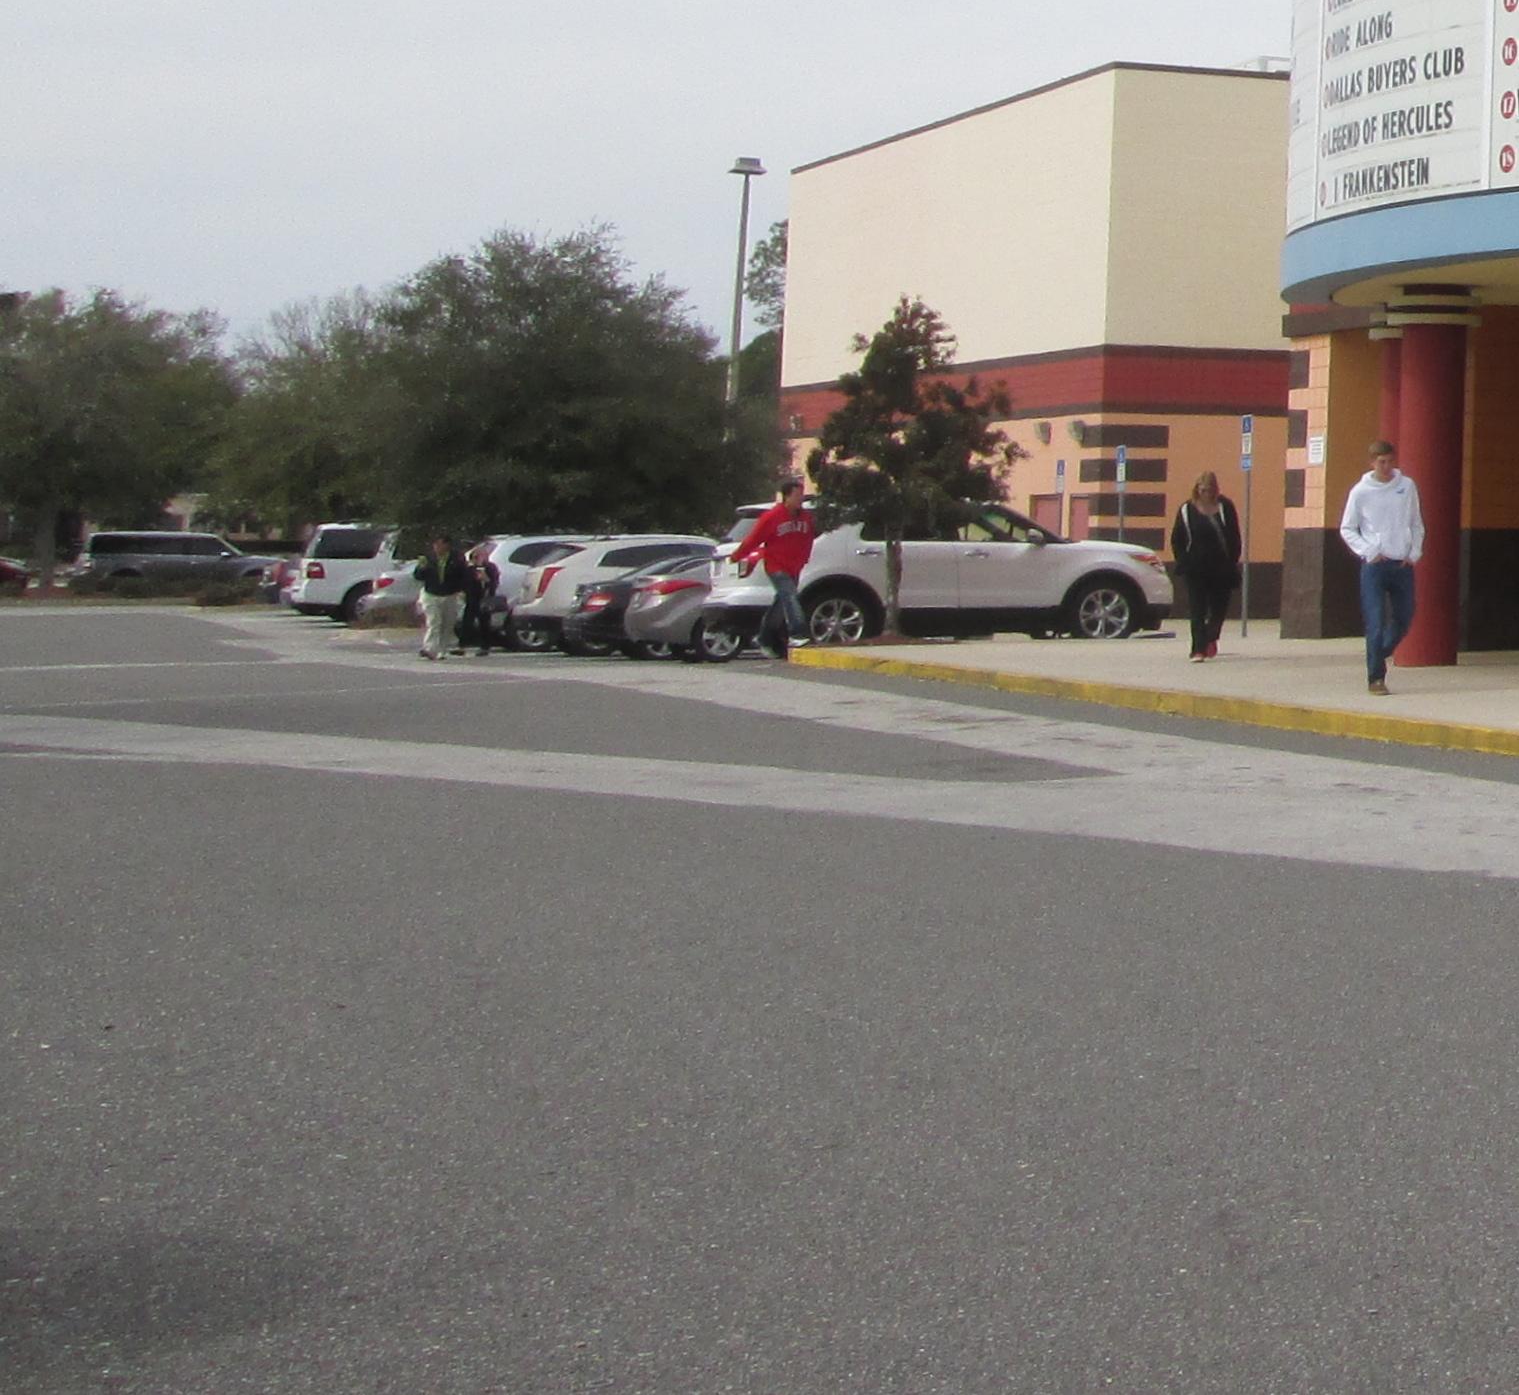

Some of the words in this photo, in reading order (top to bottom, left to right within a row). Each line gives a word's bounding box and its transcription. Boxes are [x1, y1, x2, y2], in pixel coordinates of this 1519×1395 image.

[1355, 11, 1393, 48] ALONG
[1367, 55, 1417, 93] BUYERS
[1423, 46, 1465, 80] CLUB
[1327, 121, 1360, 156] LEGEND
[1362, 116, 1377, 145] OF
[1382, 100, 1453, 141] HERCULES
[1342, 157, 1430, 201] FRANKENSTEIN
